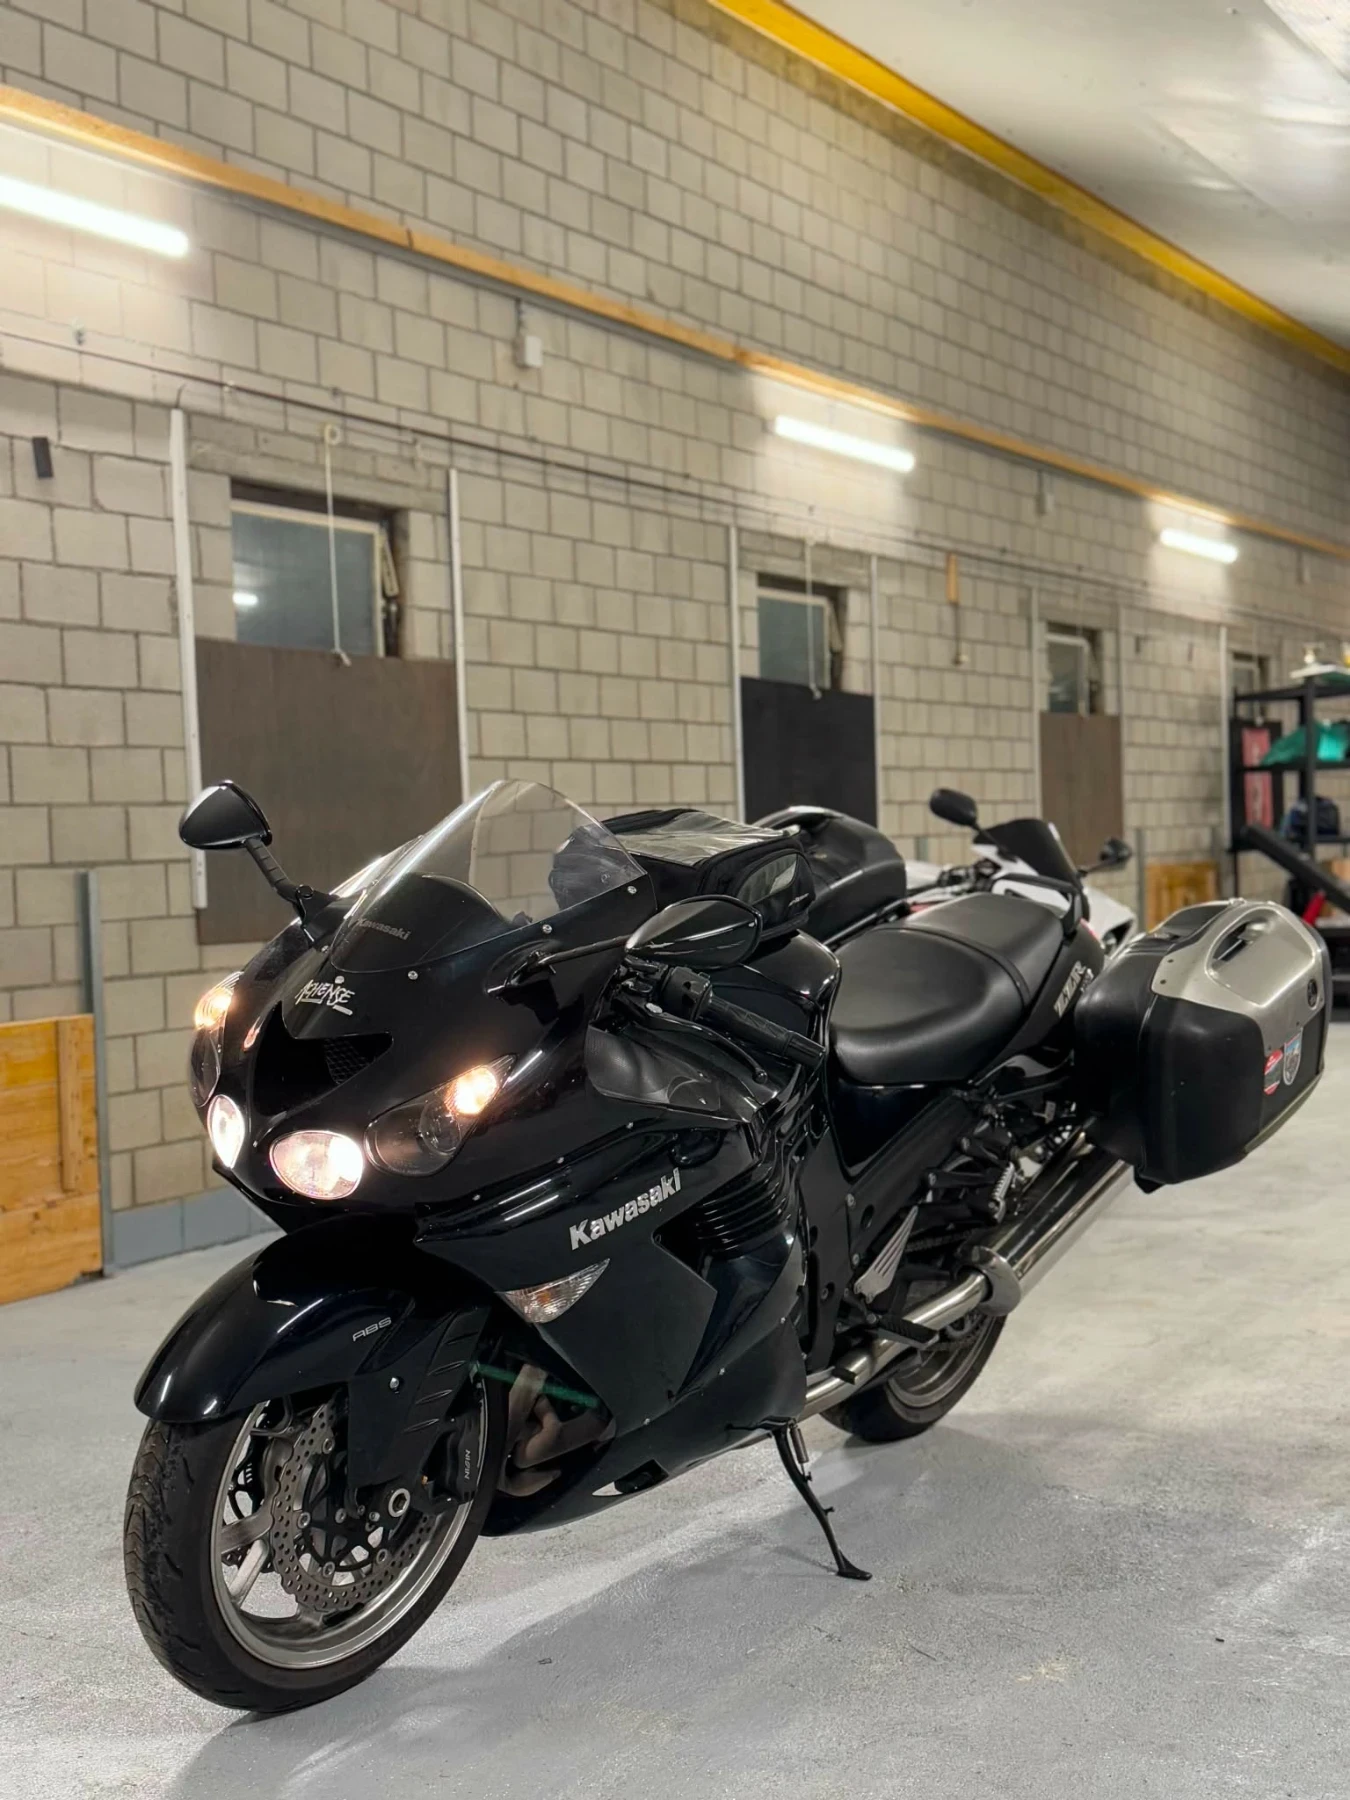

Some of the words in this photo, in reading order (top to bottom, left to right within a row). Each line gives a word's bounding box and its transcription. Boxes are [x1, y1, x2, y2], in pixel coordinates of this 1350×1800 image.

[358, 918, 411, 940] Kawasaki
[1053, 960, 1086, 1018] ZZR
[569, 1167, 682, 1251] Kawasaki
[352, 1316, 392, 1342] ABS
